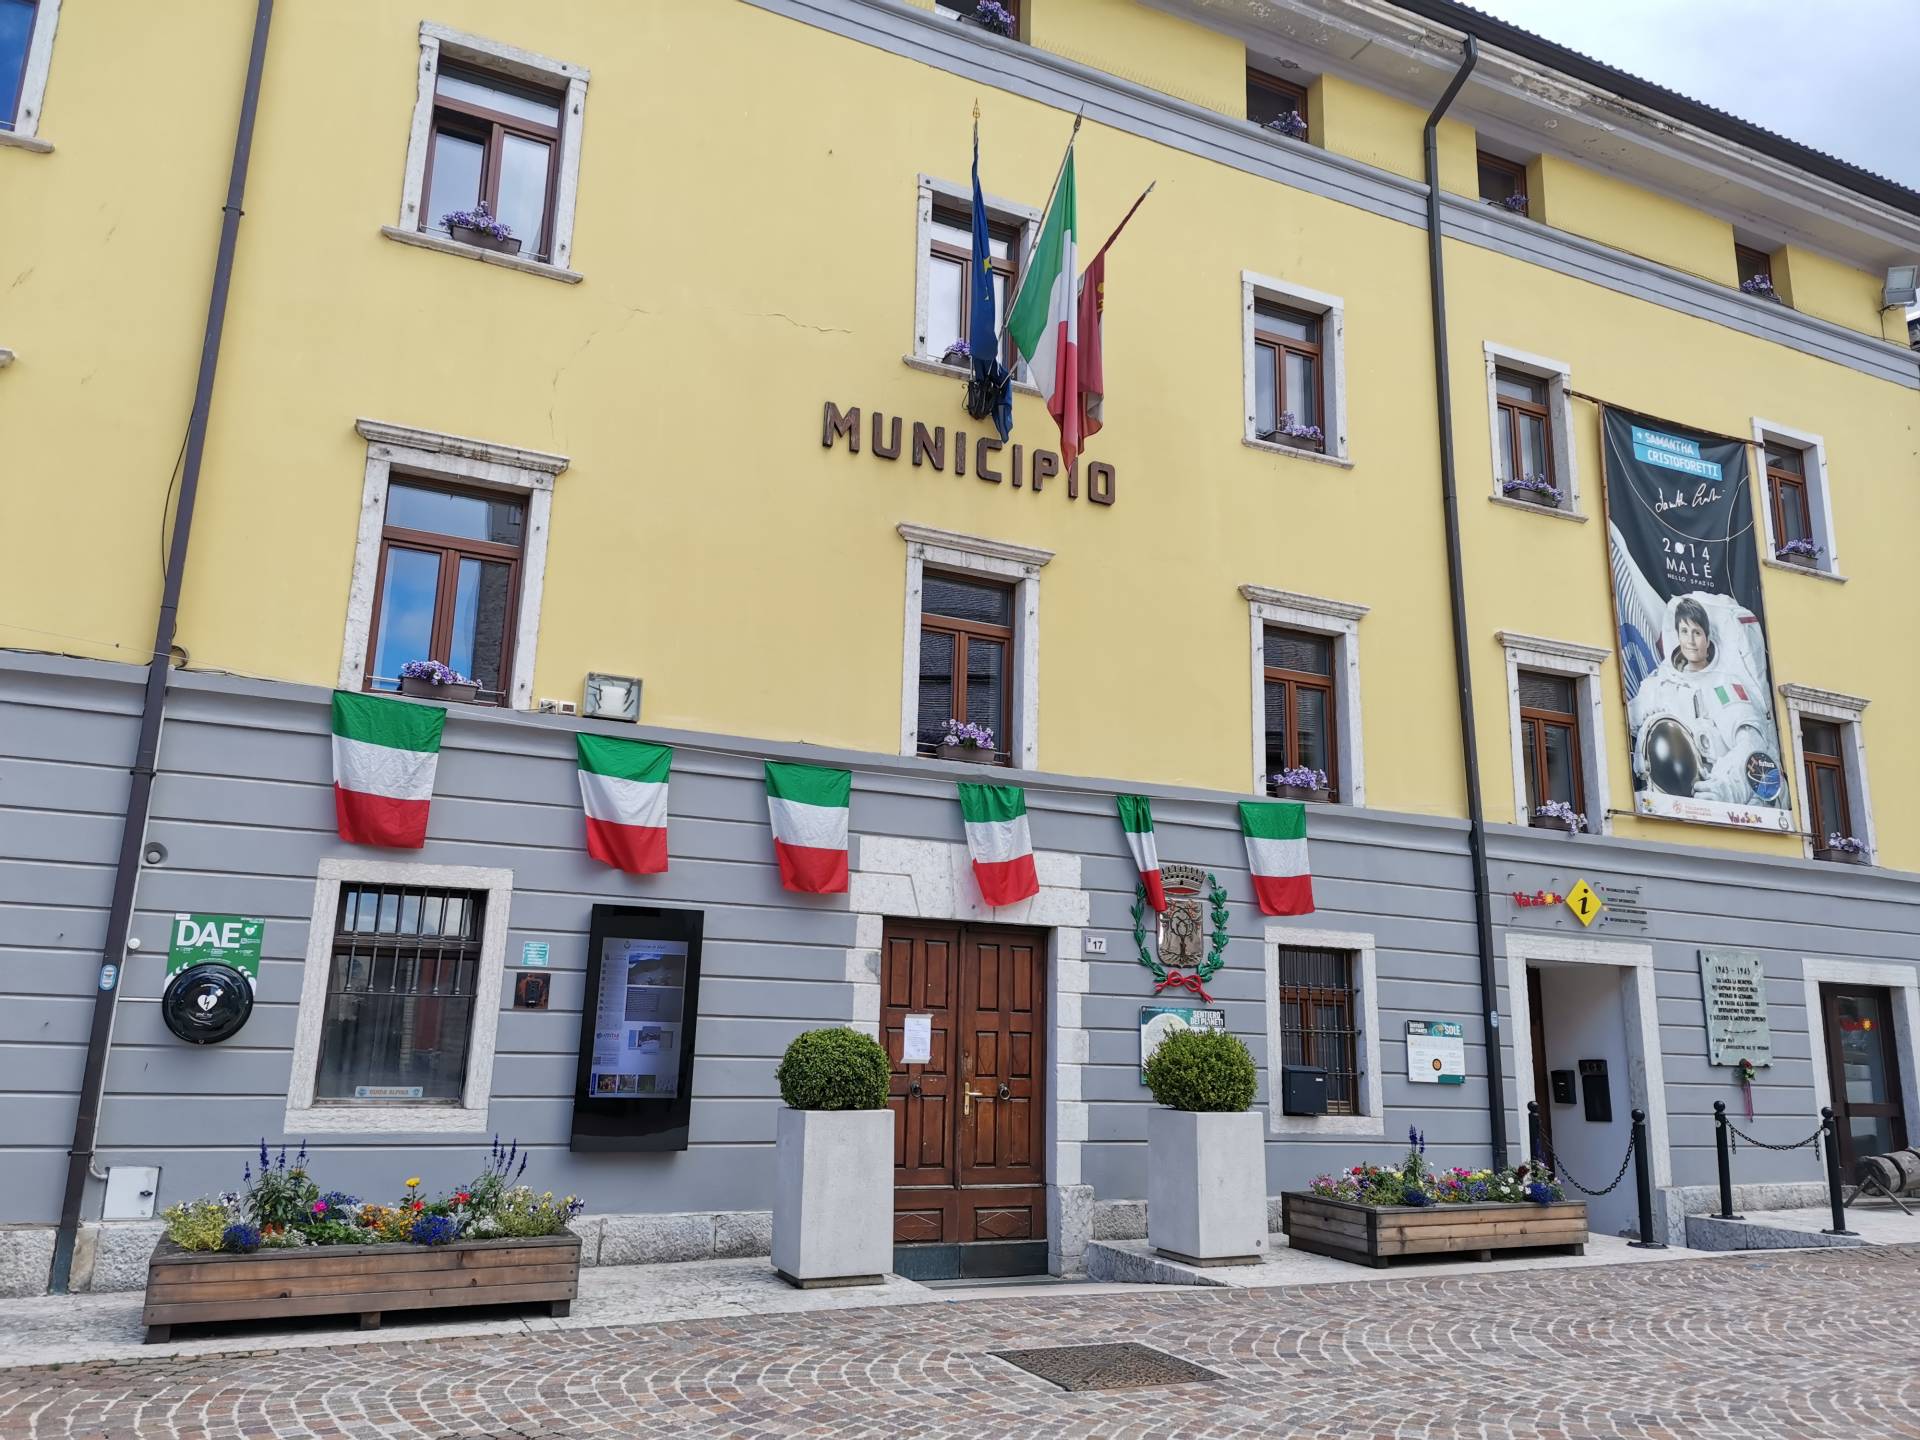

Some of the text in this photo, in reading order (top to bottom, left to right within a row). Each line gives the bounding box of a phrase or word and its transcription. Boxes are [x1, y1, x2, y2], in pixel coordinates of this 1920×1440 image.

[822, 401, 1116, 506] MUNICIPIO
[1644, 432, 1695, 456] SAMANTHA
[1647, 449, 1719, 477] CRISTOFORETTI
[1666, 556, 1713, 579] MALÉ
[1667, 573, 1715, 588] NELLO SPAZIO
[176, 920, 243, 949] DAE
[1092, 940, 1103, 950] 17
[1190, 1017, 1200, 1025] DEI
[1192, 1010, 1221, 1019] SENTIERO
[1444, 1024, 1462, 1036] SOLE
